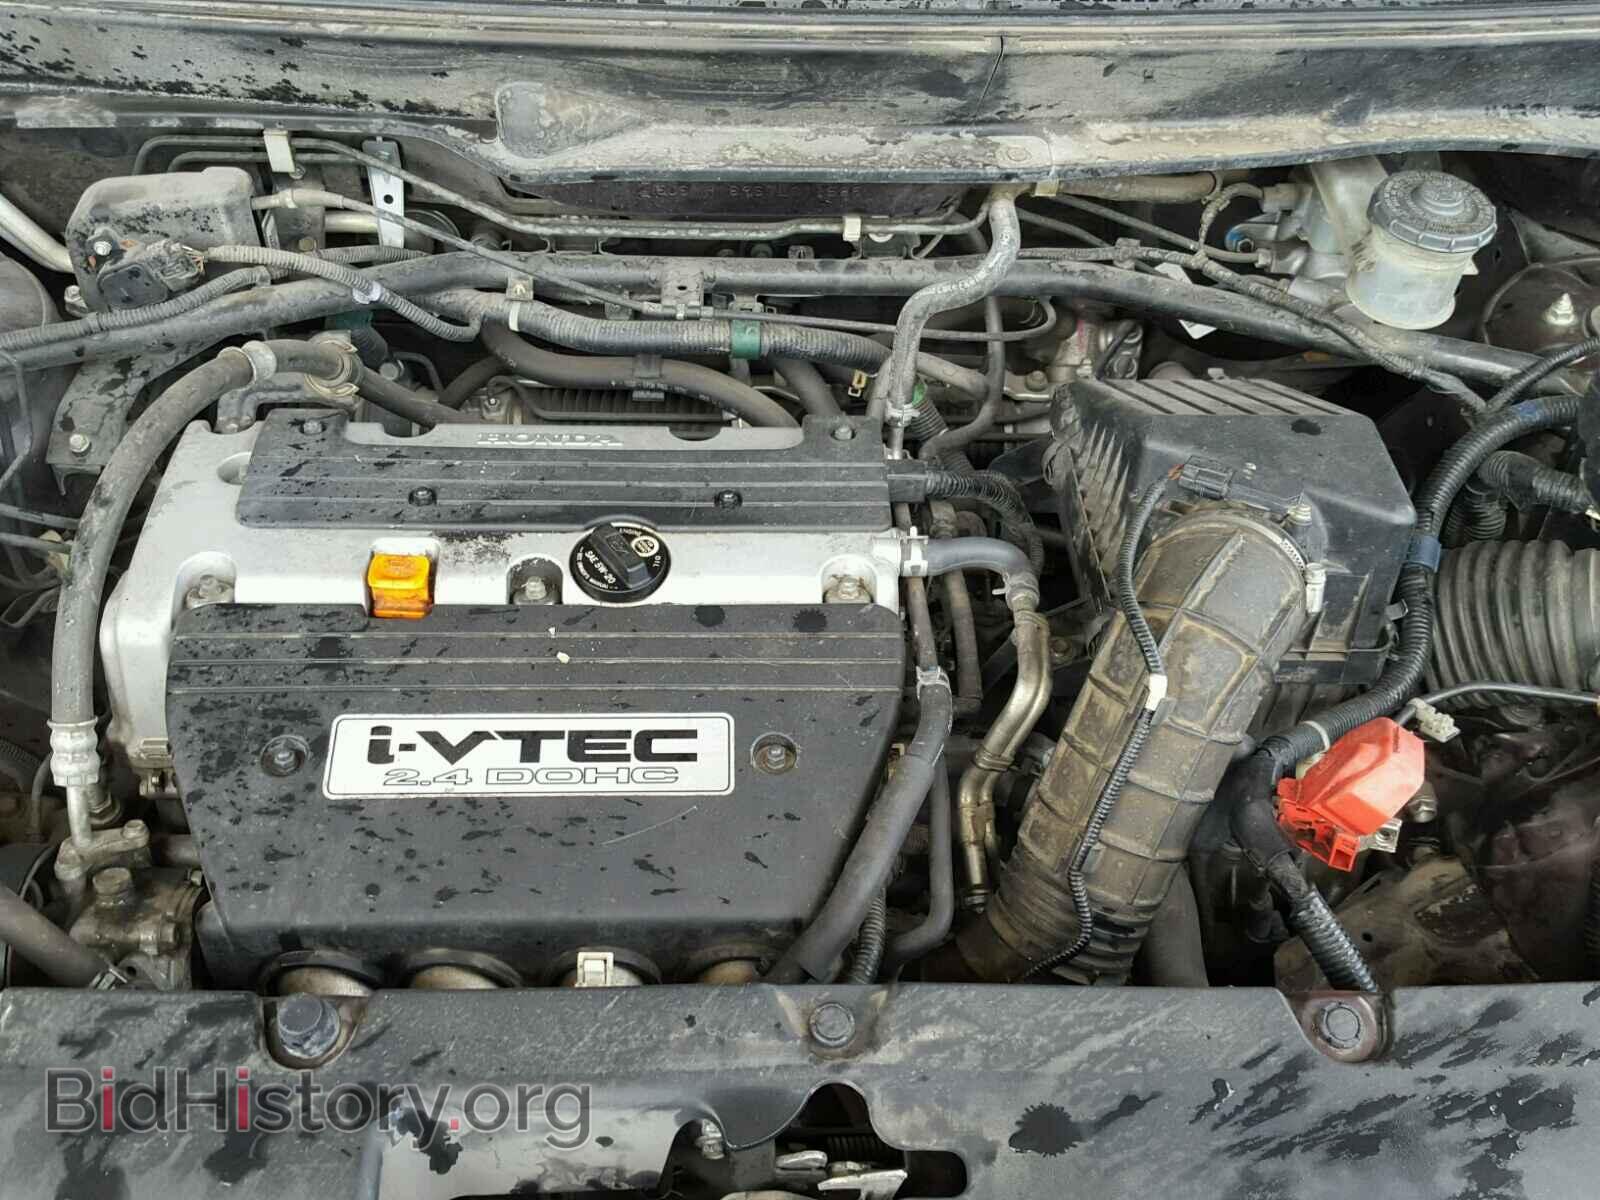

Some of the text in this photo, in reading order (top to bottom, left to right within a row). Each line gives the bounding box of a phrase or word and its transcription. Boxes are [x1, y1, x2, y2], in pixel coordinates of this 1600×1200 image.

[477, 432, 623, 445] HONDA
[585, 551, 599, 564] SAE
[594, 562, 616, 584] 5W-20
[652, 555, 662, 568] OIL
[367, 725, 698, 764] i-VTEC
[383, 766, 679, 786] 2.4 DOHC
